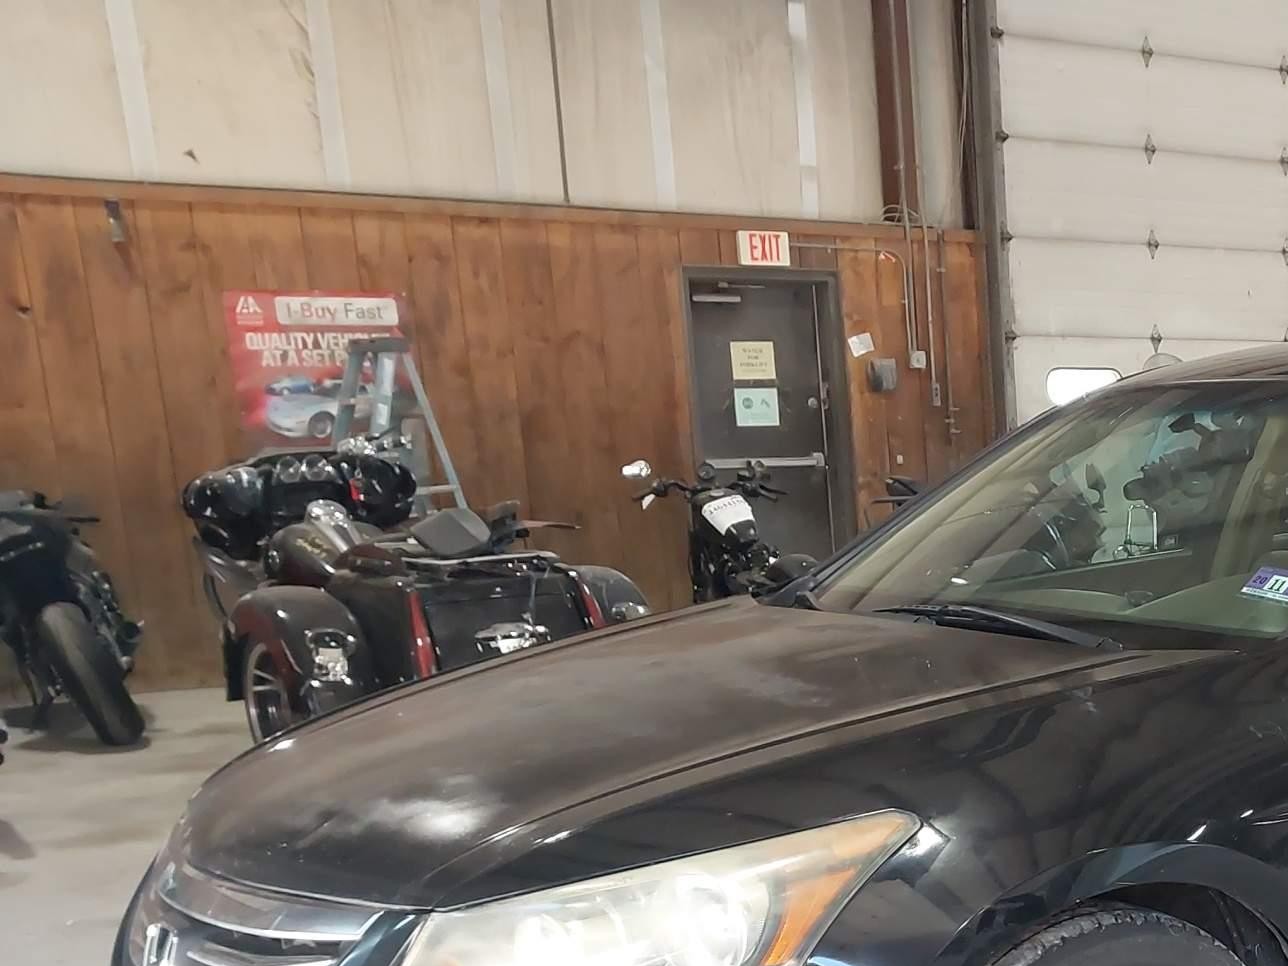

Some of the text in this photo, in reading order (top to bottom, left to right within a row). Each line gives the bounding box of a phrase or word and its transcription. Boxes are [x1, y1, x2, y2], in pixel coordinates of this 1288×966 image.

[749, 233, 781, 262] EXIT
[286, 302, 337, 321] I-Buy
[343, 302, 384, 320] Fast
[245, 332, 317, 350] QUALITY
[262, 350, 284, 367] AT
[285, 350, 300, 367] A
[302, 350, 333, 367] SET
[1253, 576, 1268, 584] 20
[1268, 579, 1287, 591] 11
